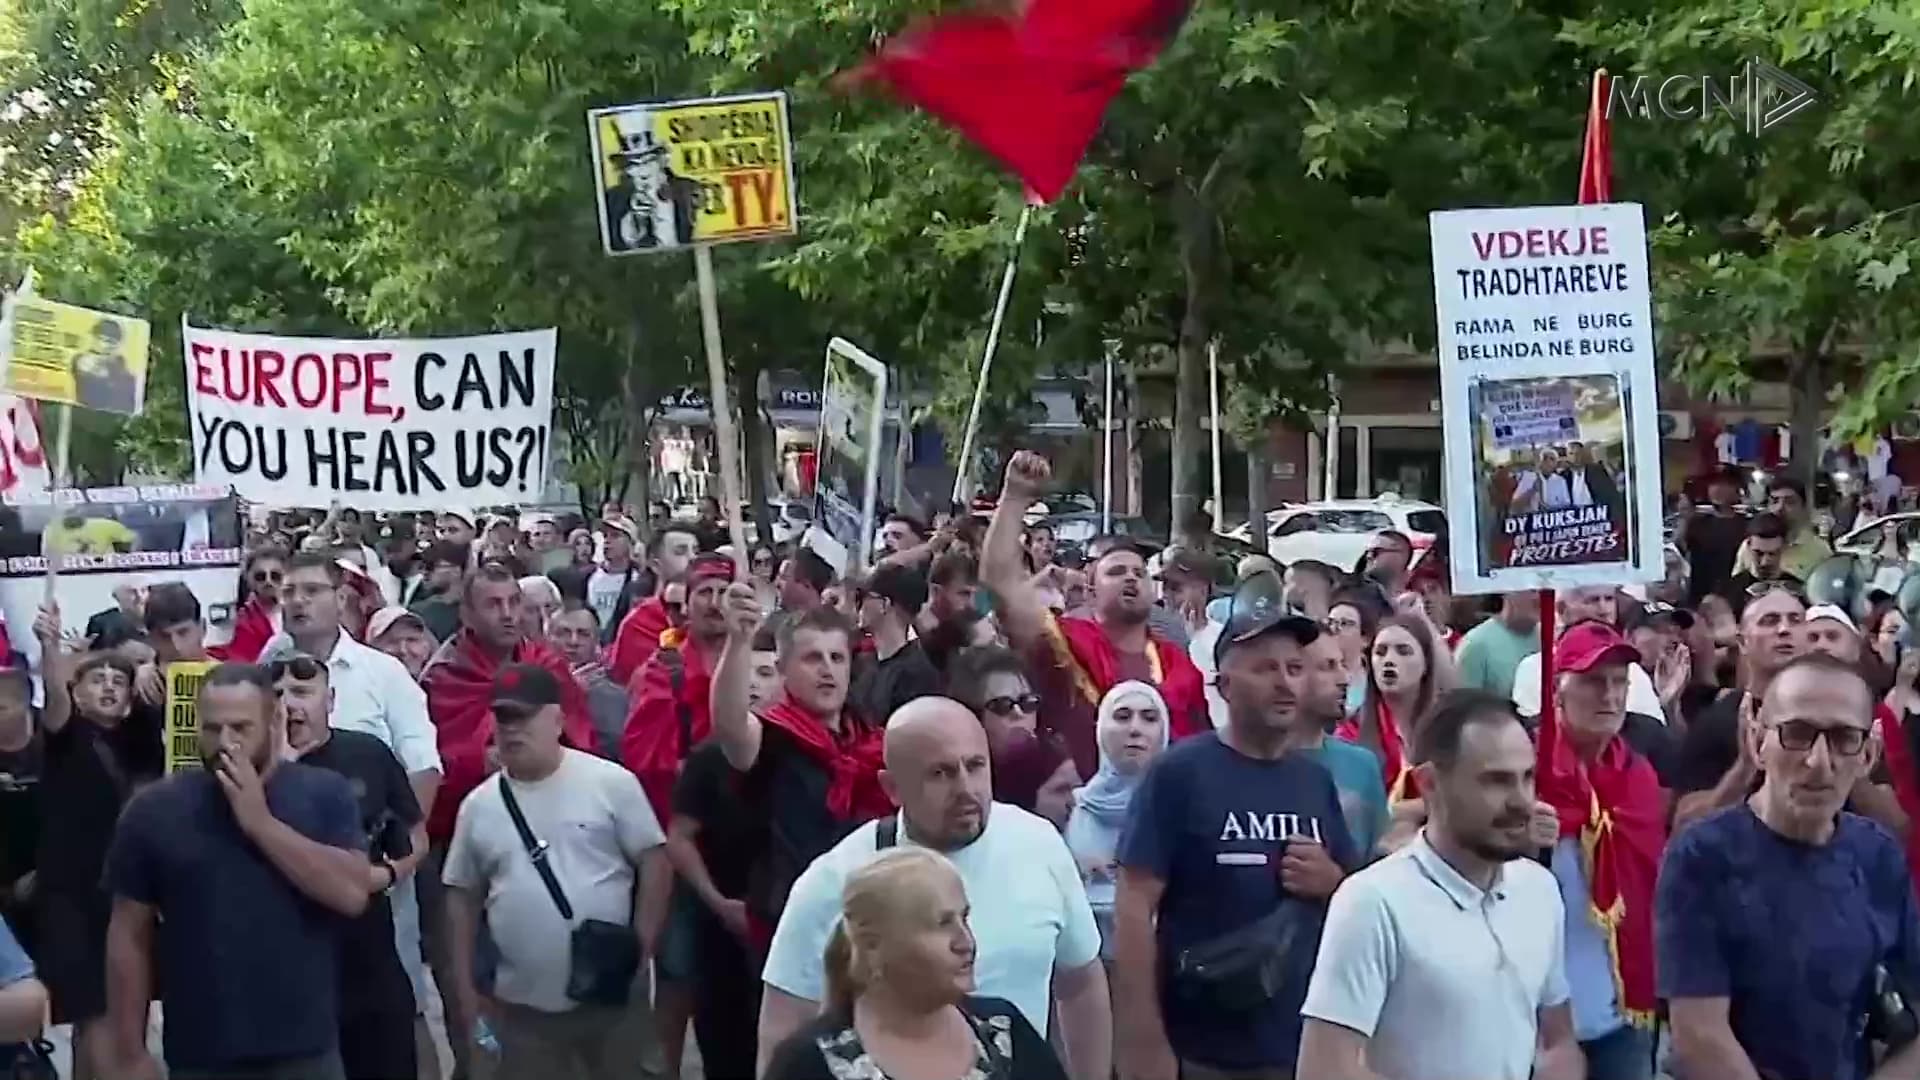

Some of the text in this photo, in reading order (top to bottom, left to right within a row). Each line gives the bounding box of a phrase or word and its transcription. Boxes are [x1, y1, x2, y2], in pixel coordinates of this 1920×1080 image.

[1471, 226, 1610, 262] VDEKJE
[1457, 263, 1629, 300] TRADHTAREVE
[1455, 313, 1633, 336] RAMA NE BURG
[1457, 337, 1635, 361] BELINDA NE BURG
[191, 342, 536, 423] EUROPE, CAN
[199, 412, 288, 482] YOU
[304, 427, 447, 496] HEAR
[1505, 504, 1608, 534] DY KUKSJAN
